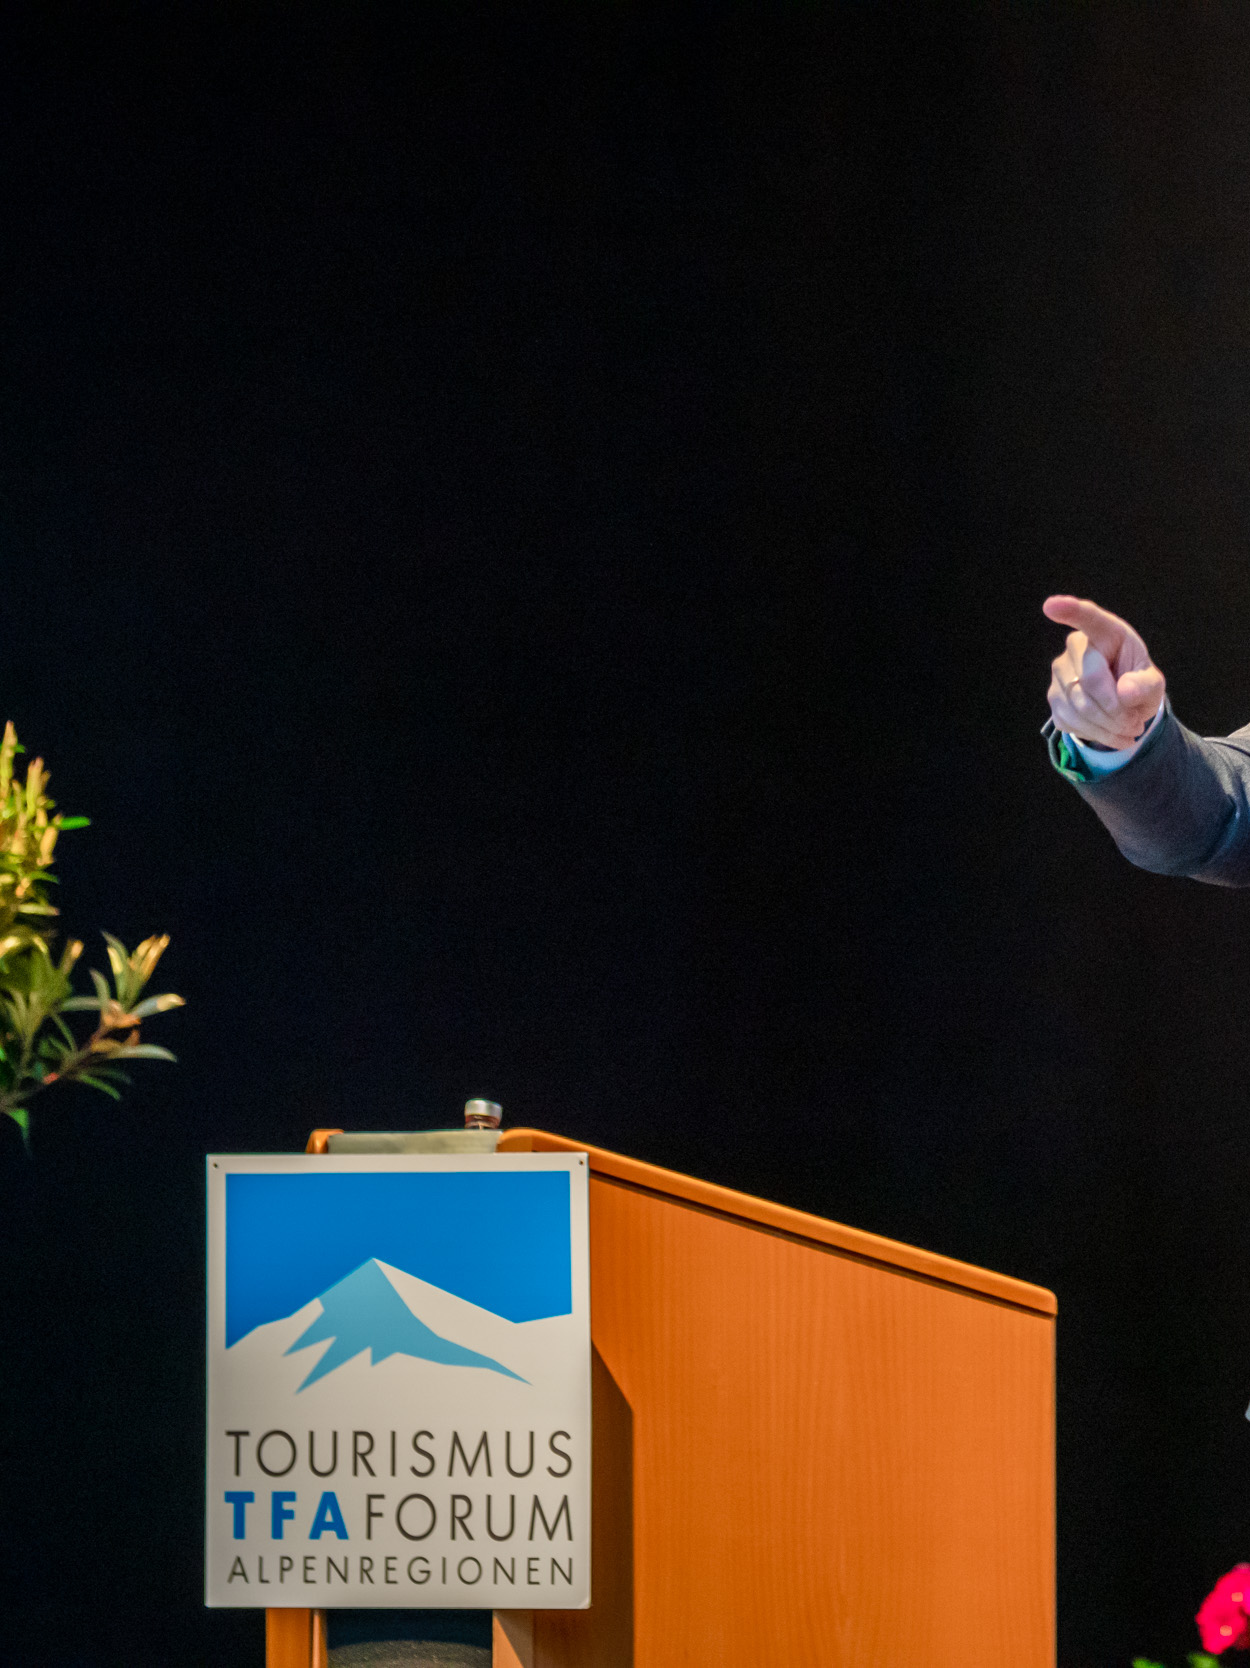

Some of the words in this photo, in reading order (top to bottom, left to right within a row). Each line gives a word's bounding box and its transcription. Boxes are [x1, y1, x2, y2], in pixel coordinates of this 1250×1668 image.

[224, 1428, 573, 1479] TOURISMUS
[223, 1490, 350, 1541] TFA
[365, 1492, 574, 1542] FORUM
[226, 1555, 574, 1586] ALPENREGIONEN
